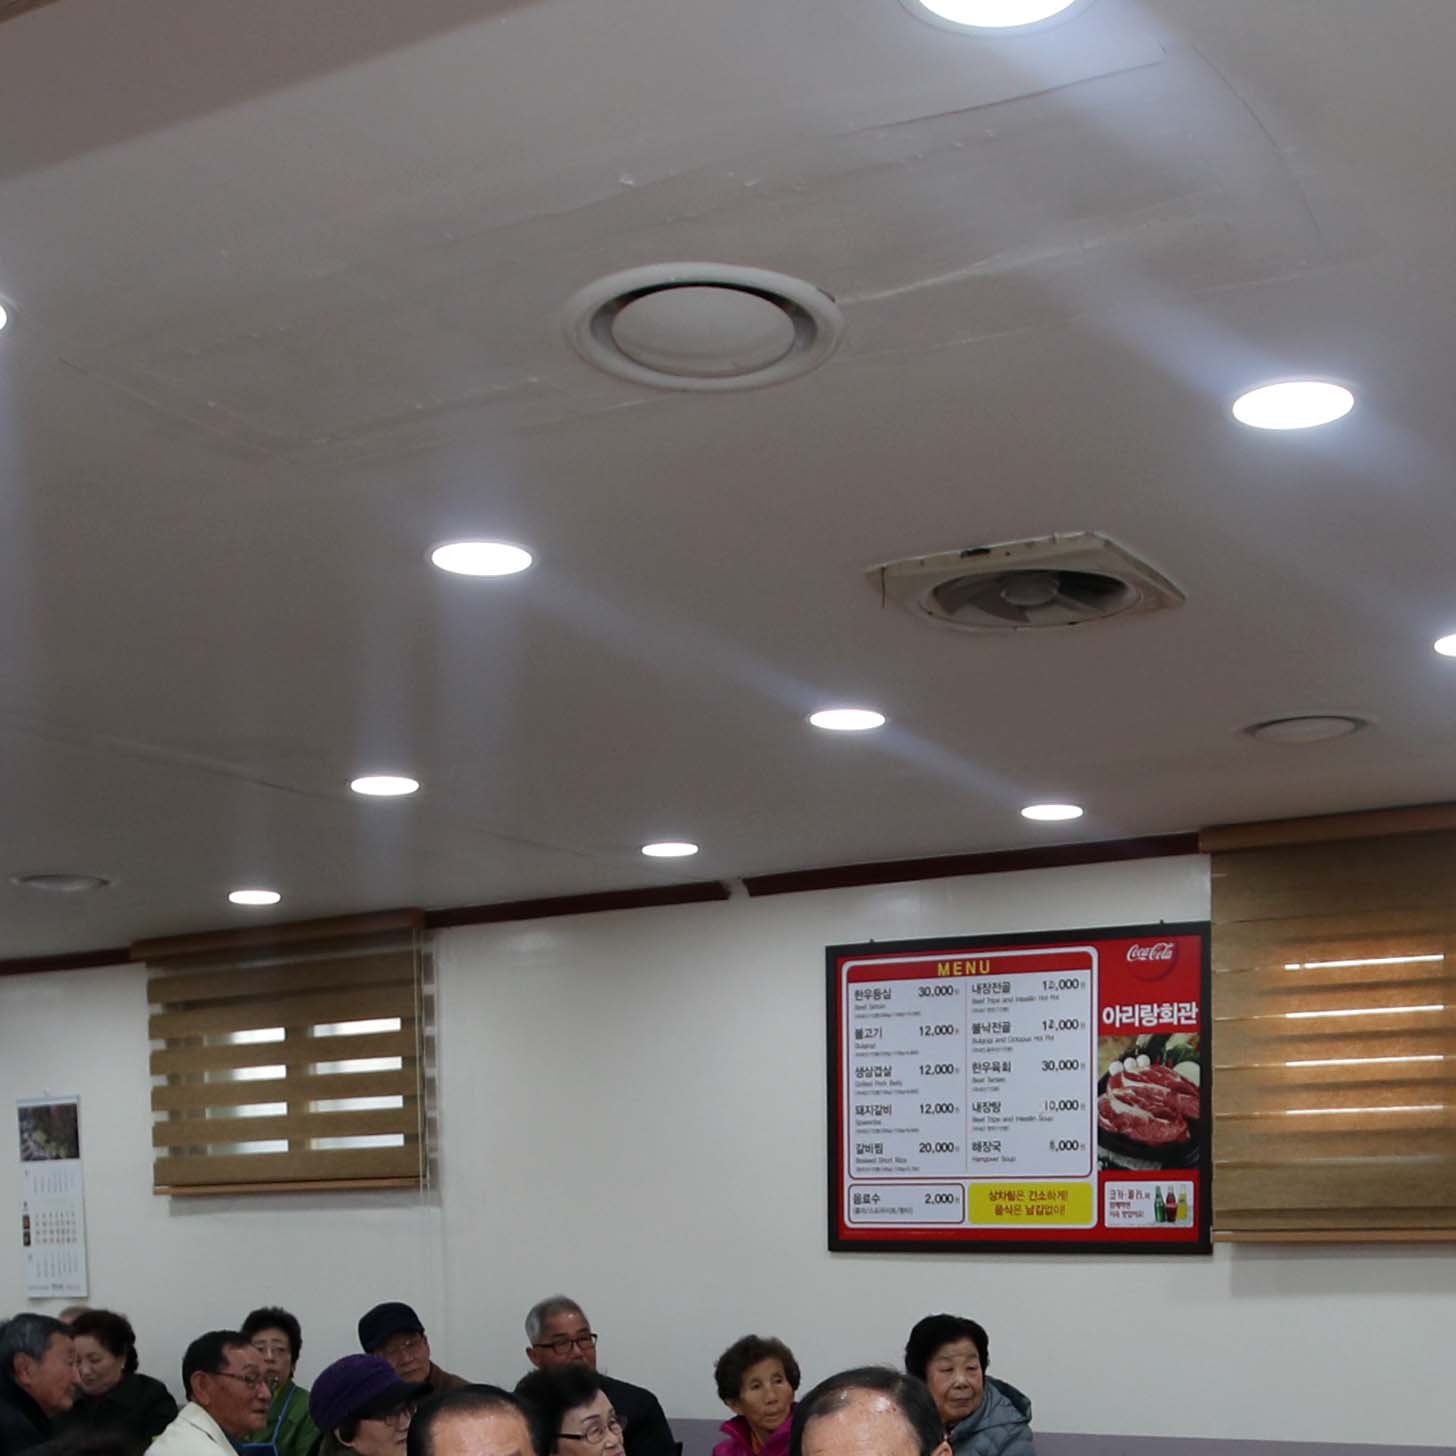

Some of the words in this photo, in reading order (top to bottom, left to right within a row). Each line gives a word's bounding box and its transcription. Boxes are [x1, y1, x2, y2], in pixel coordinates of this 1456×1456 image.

[937, 960, 990, 976] MENU
[855, 987, 891, 1001] 한우등심
[1102, 1002, 1198, 1028] 아리랑회관
[855, 1027, 882, 1040] 불고기
[856, 1065, 892, 1078] 생삼겹살
[855, 1104, 891, 1116] 돼지갈비
[853, 1193, 880, 1205] 음료수
